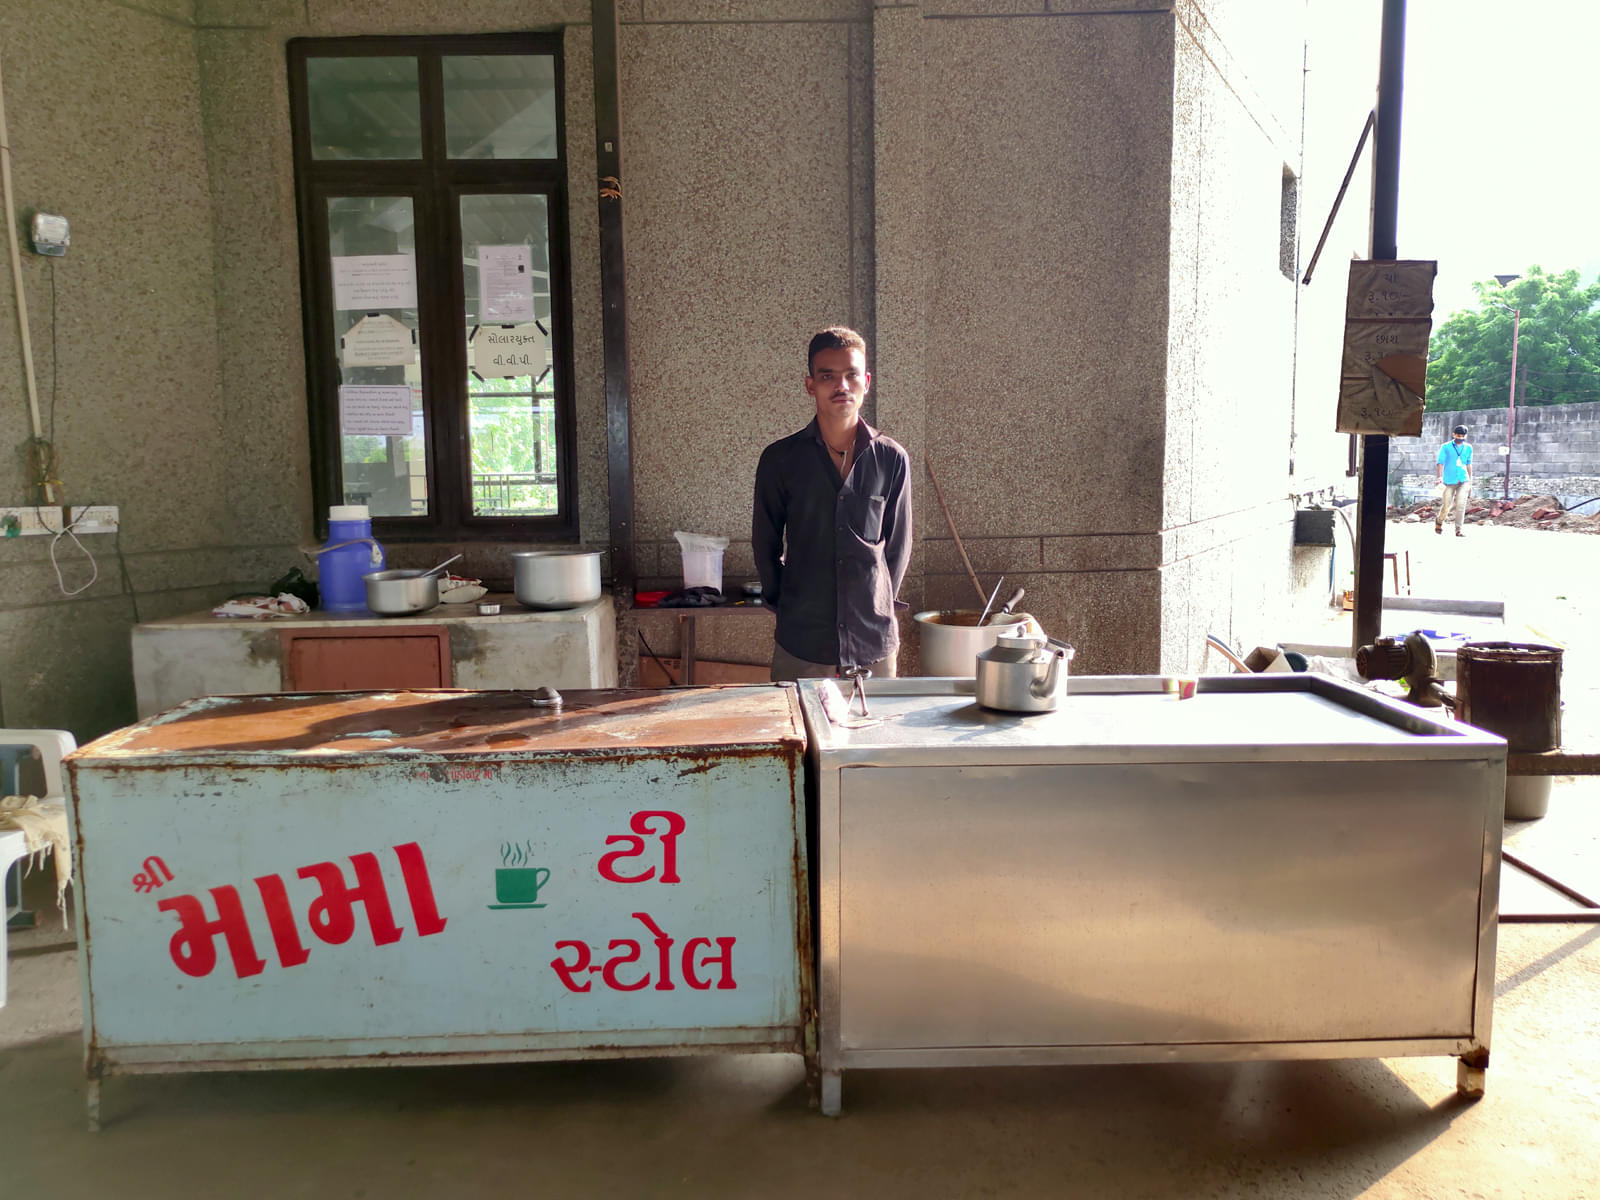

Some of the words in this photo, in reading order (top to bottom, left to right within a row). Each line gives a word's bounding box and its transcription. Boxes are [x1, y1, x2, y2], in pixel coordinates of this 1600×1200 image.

[487, 333, 535, 345] સોલારયુક્ત
[492, 353, 533, 366] વી.વી.પી.
[132, 856, 175, 893] શ્રી
[597, 810, 686, 884] ટી
[157, 841, 448, 979] મામા
[550, 912, 737, 993] સ્ટોલ
